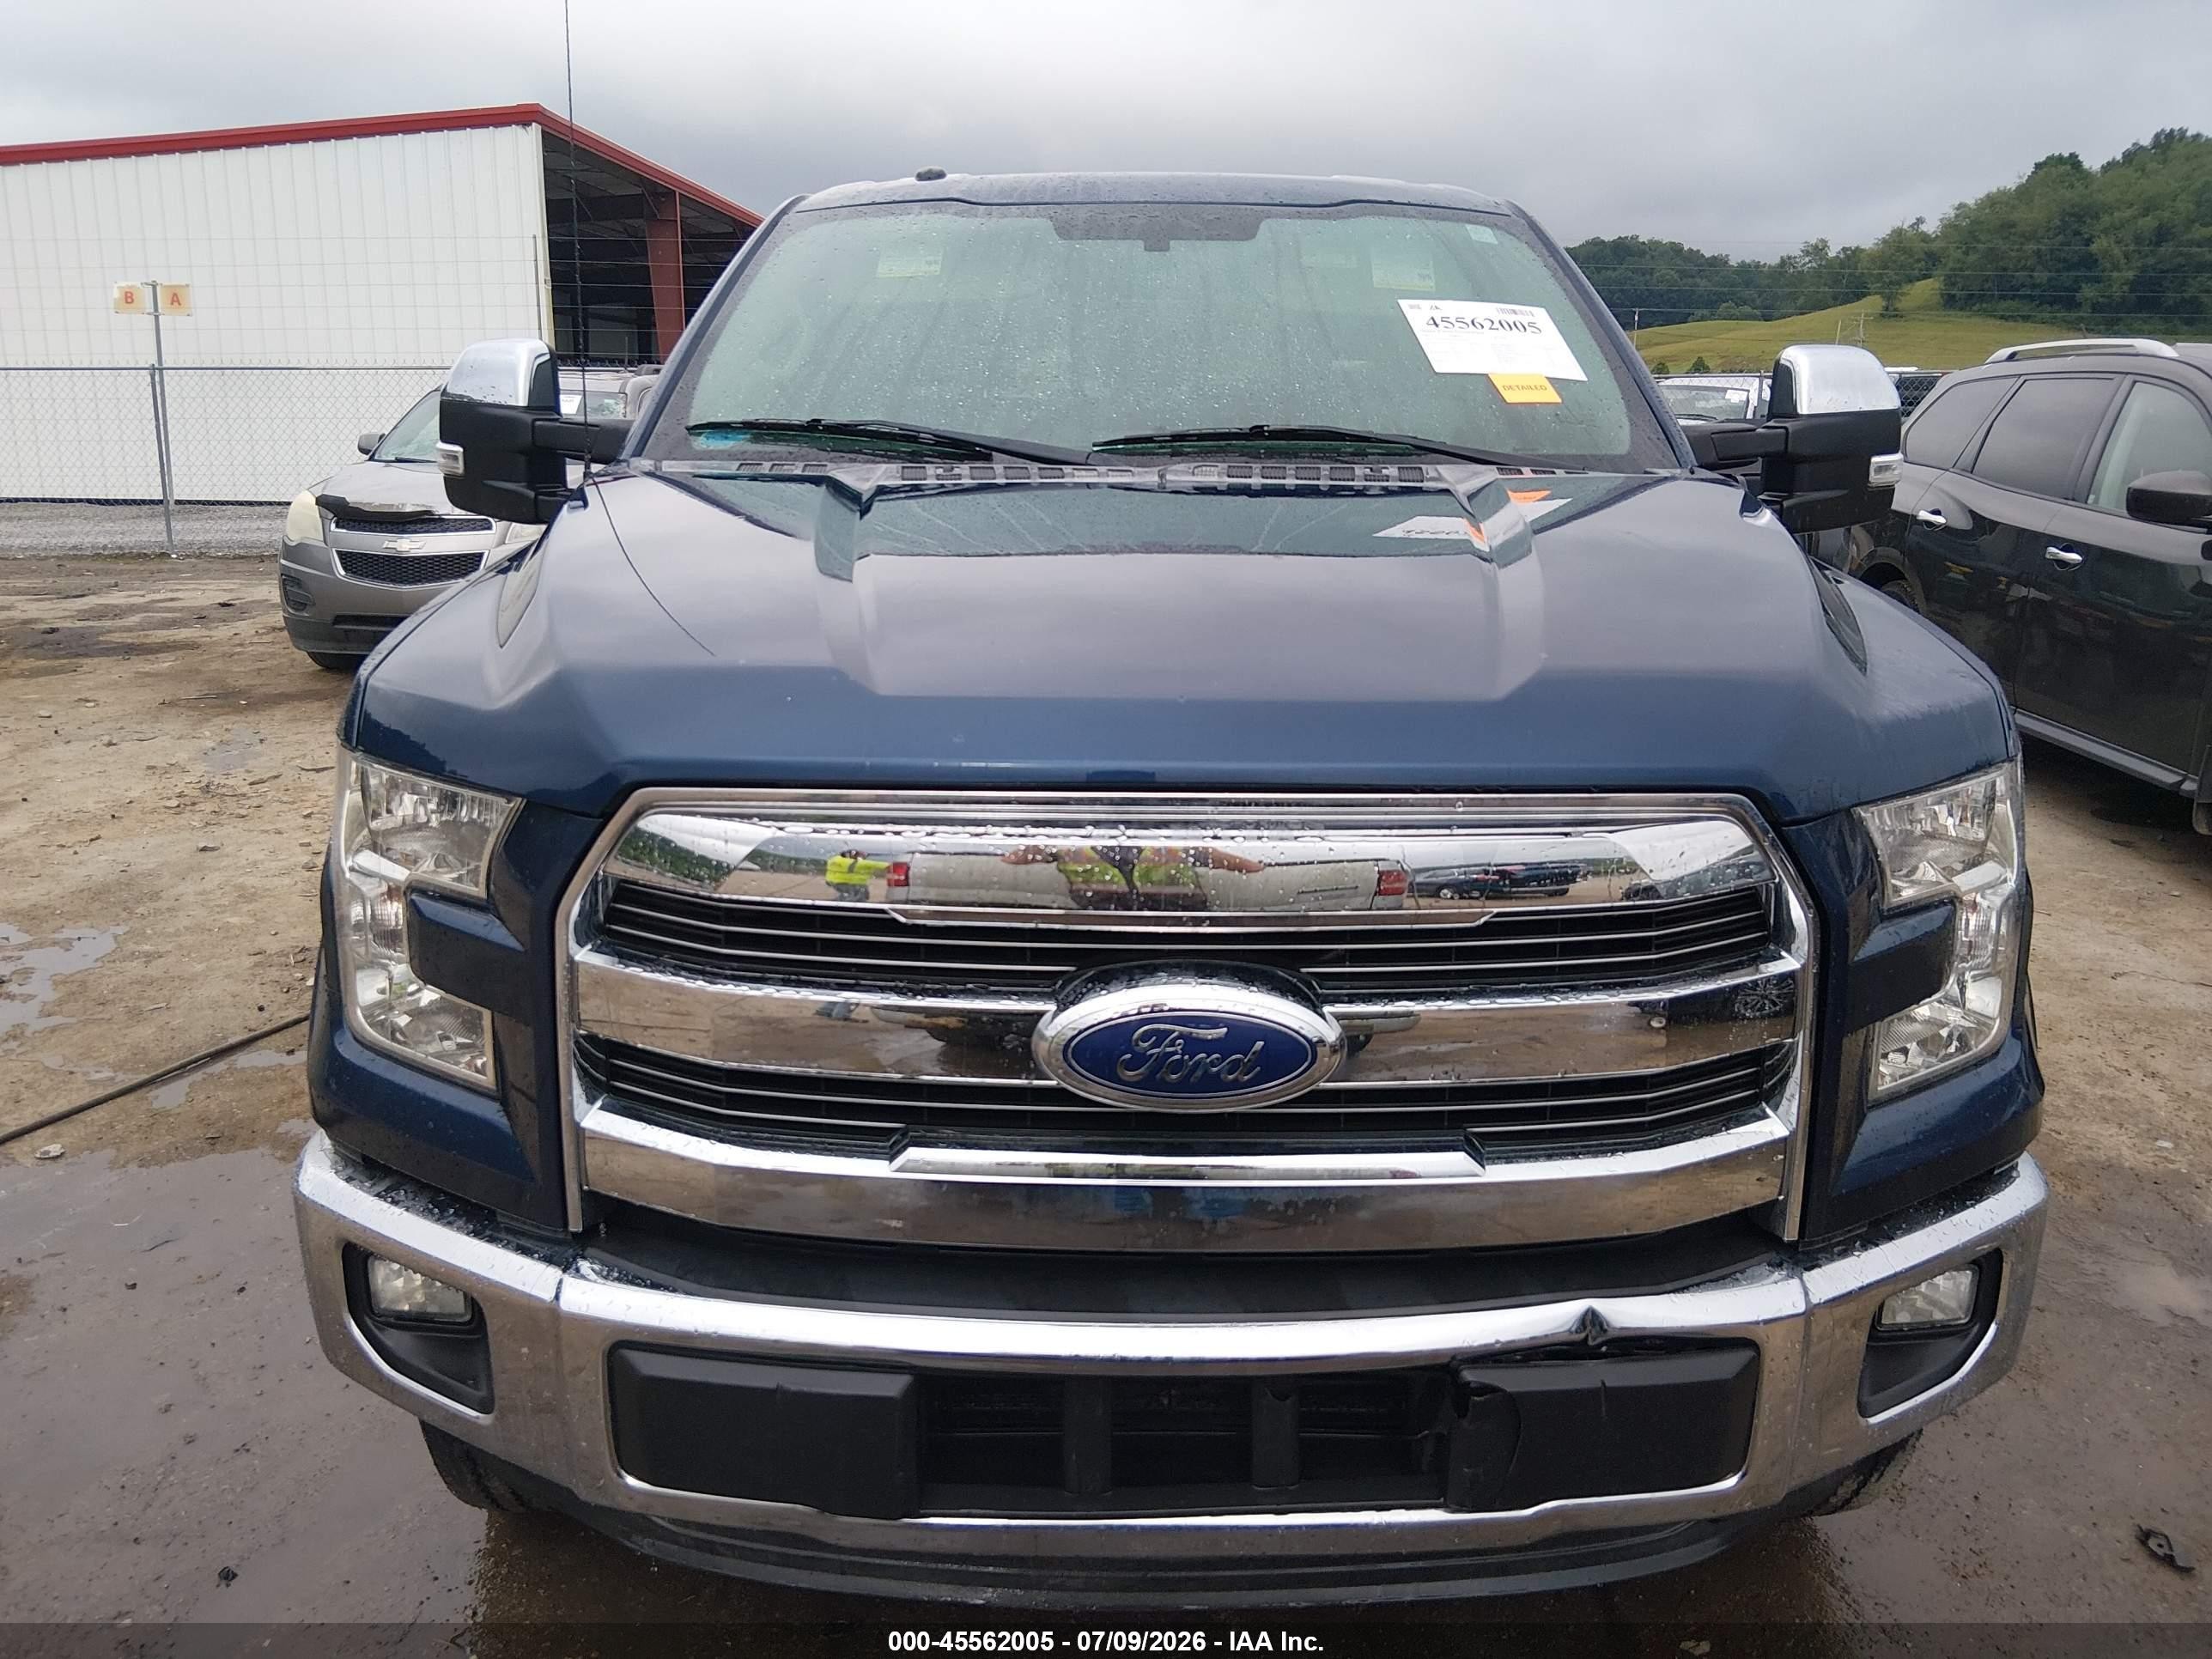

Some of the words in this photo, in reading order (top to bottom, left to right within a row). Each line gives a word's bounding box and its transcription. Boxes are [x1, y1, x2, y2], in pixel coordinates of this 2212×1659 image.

[125, 291, 135, 304] B
[170, 293, 181, 306] A
[1425, 315, 1542, 335] 45562005
[1116, 1023, 1265, 1084] Ford
